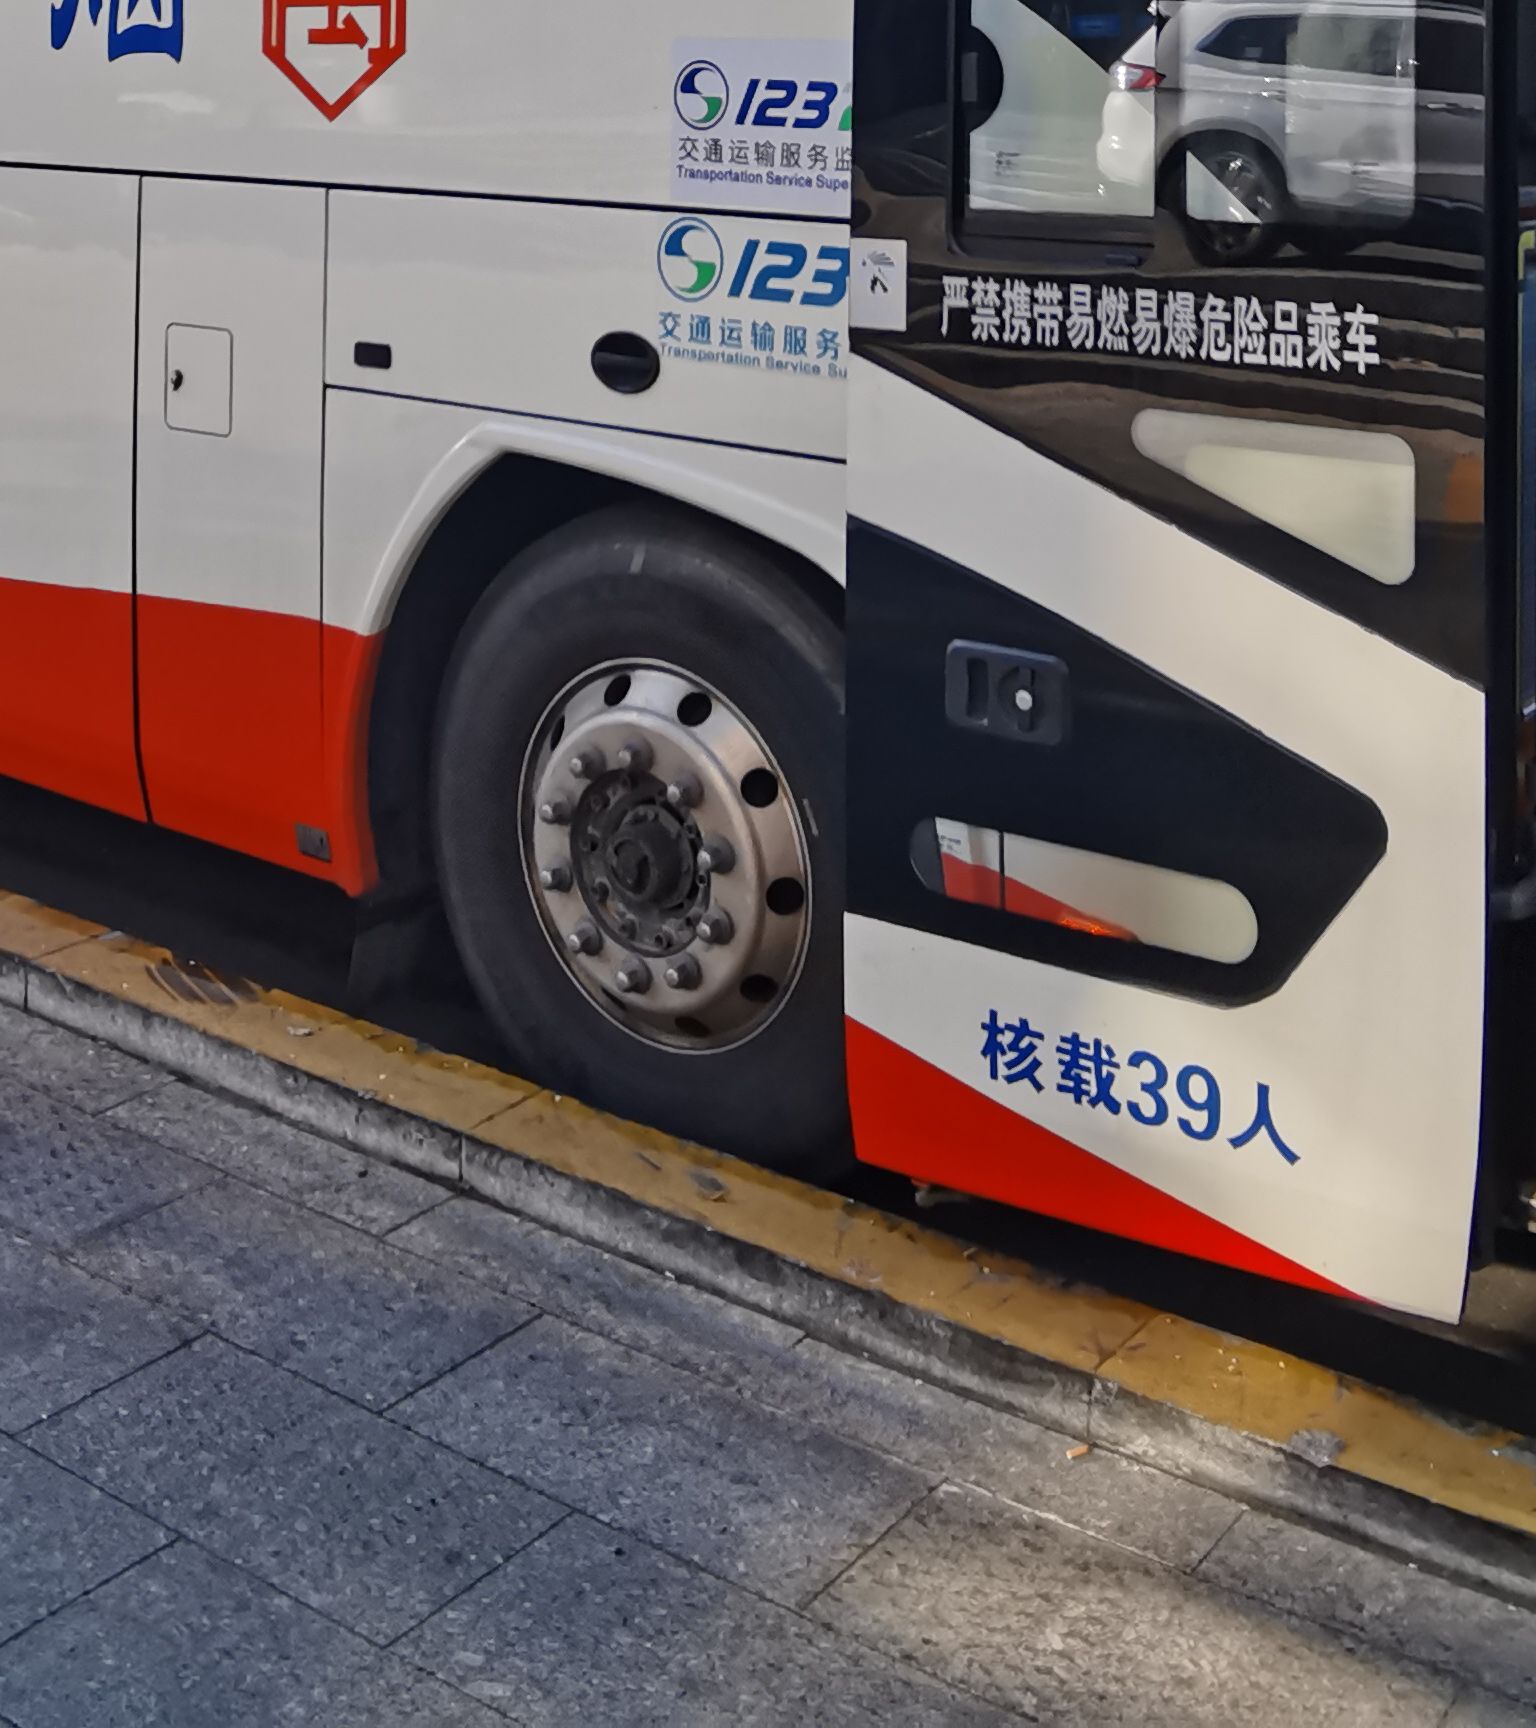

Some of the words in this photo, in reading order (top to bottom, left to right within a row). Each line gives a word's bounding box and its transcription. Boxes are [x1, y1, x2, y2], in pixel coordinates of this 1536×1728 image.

[676, 164, 763, 185] Transportation
[766, 170, 813, 188] Service
[658, 310, 841, 362] 交通运输服务
[939, 273, 1382, 377] 严禁携带易燃易爆危险品乘车
[659, 342, 761, 368] Transportation
[765, 355, 822, 377] Service
[980, 1008, 1302, 1167] 核载39人
